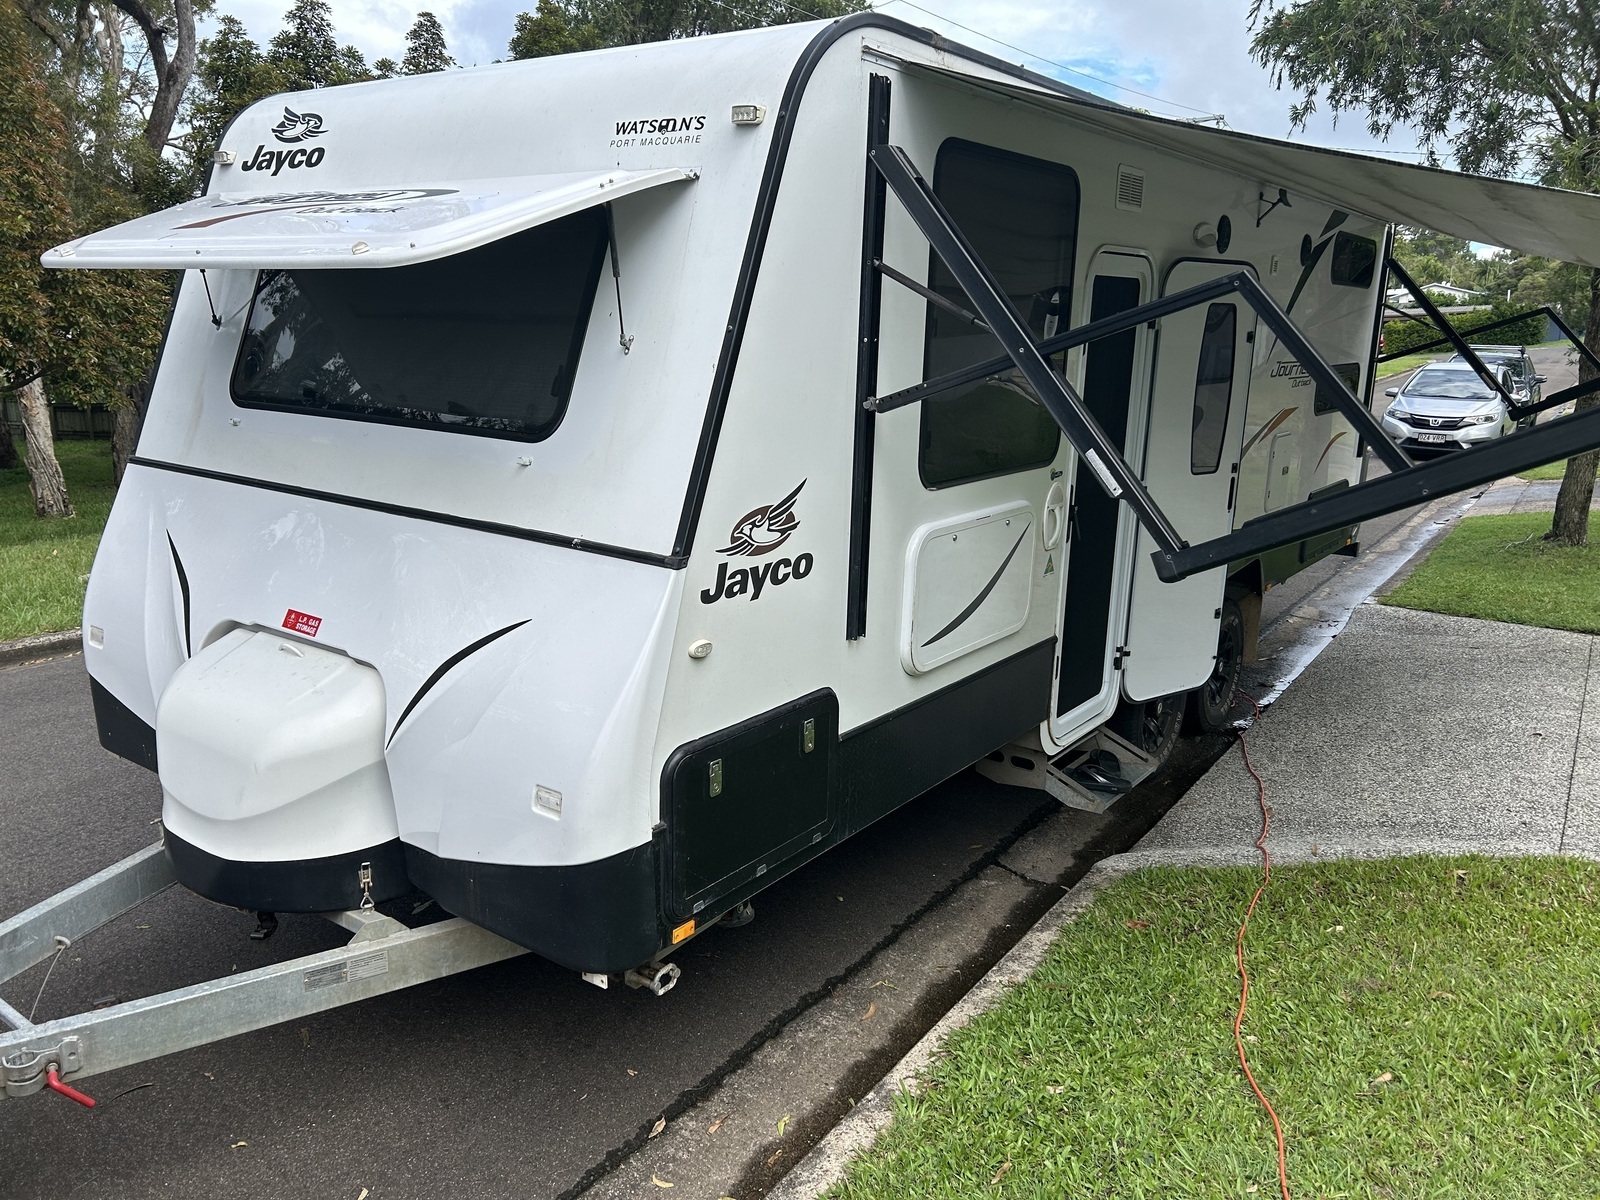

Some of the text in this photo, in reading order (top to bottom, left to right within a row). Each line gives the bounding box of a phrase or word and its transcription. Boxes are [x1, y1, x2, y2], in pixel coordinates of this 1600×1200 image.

[609, 134, 702, 148] PORT MACQUARIE
[241, 144, 326, 177] Jayco
[700, 552, 814, 605] Jayco
[295, 622, 316, 634] STORAGE
[308, 618, 319, 626] GAS
